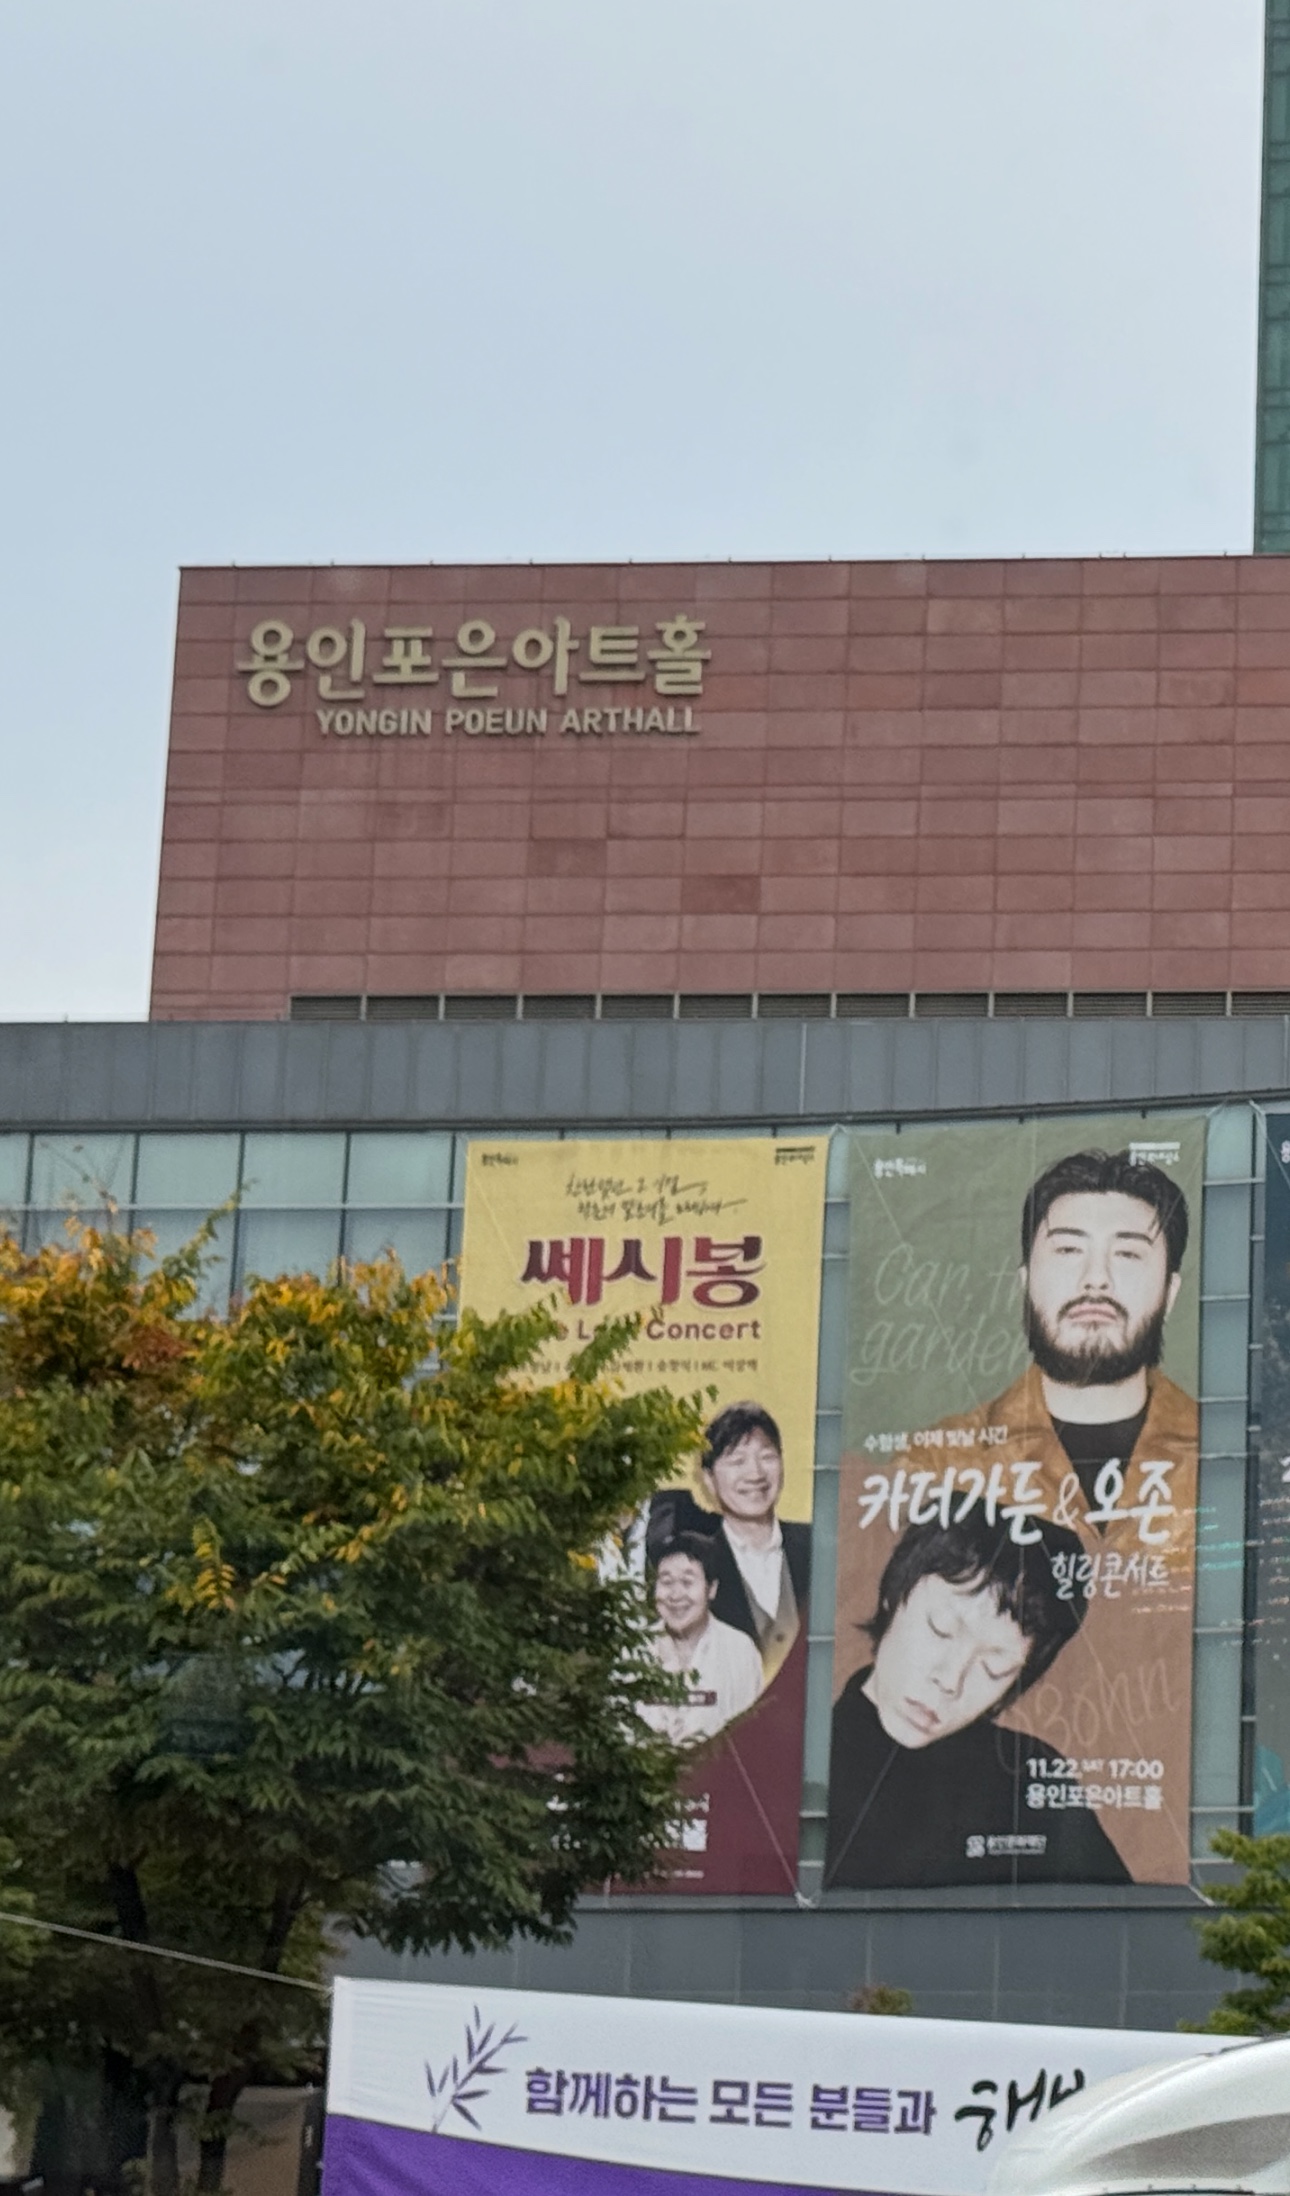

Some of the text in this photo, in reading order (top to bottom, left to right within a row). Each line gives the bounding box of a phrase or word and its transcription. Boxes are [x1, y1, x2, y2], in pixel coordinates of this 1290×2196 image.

[236, 613, 712, 708] 용인포은아트홀
[315, 706, 701, 735] YONGIN POEUN ARTHALL
[646, 1319, 761, 1341] Concert
[858, 1456, 1176, 1546] 카더가든 & 오존
[1108, 1757, 1165, 1780] 17:00
[525, 2066, 699, 2125] 함께하는
[708, 2079, 793, 2129] 모든
[809, 2083, 938, 2137] 분들과
